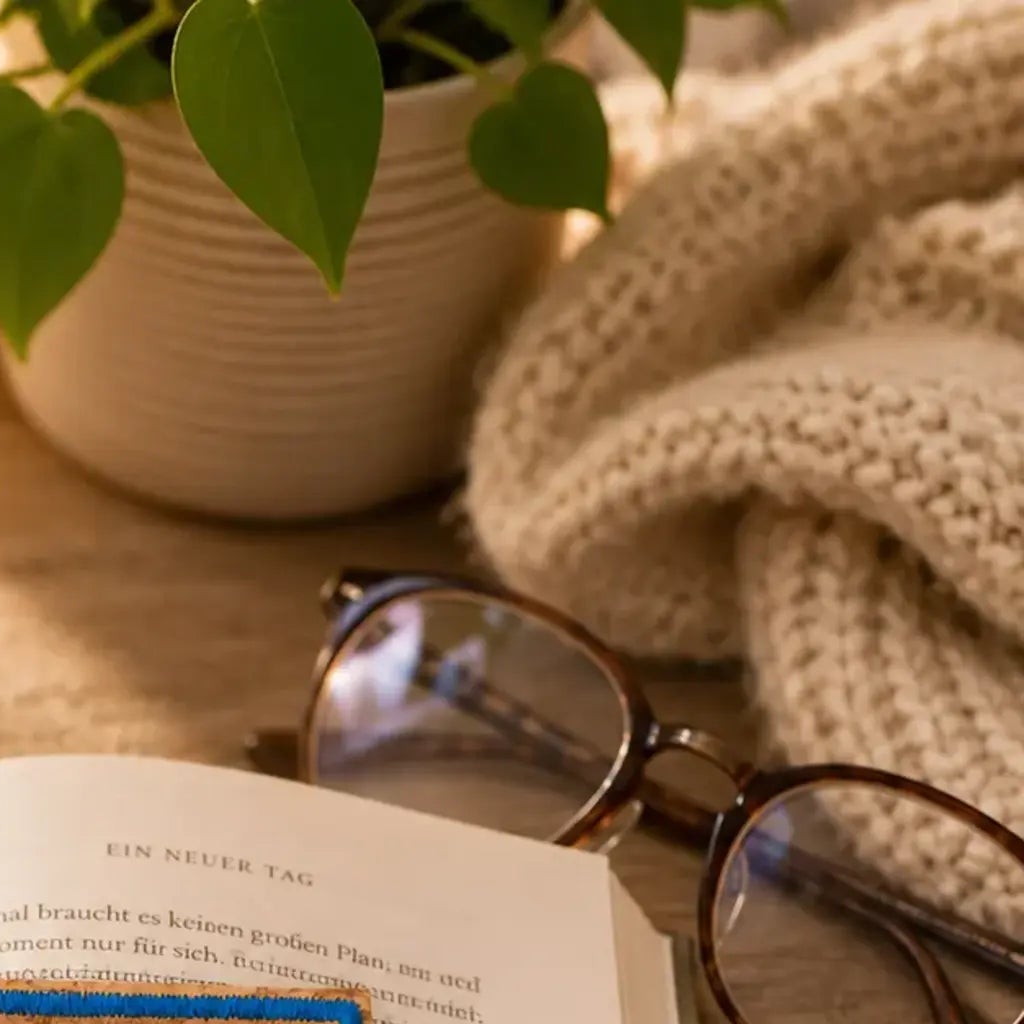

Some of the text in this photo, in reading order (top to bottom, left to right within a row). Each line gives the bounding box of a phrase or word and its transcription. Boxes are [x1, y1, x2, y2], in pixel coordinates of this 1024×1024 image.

[107, 843, 314, 887] EIN NEUER TAG
[38, 903, 129, 923] braucht
[138, 910, 161, 925] es
[169, 911, 243, 938] keinen
[250, 930, 328, 957] großen
[82, 938, 126, 953] nur
[133, 936, 167, 957] für
[173, 945, 225, 965] sich.
